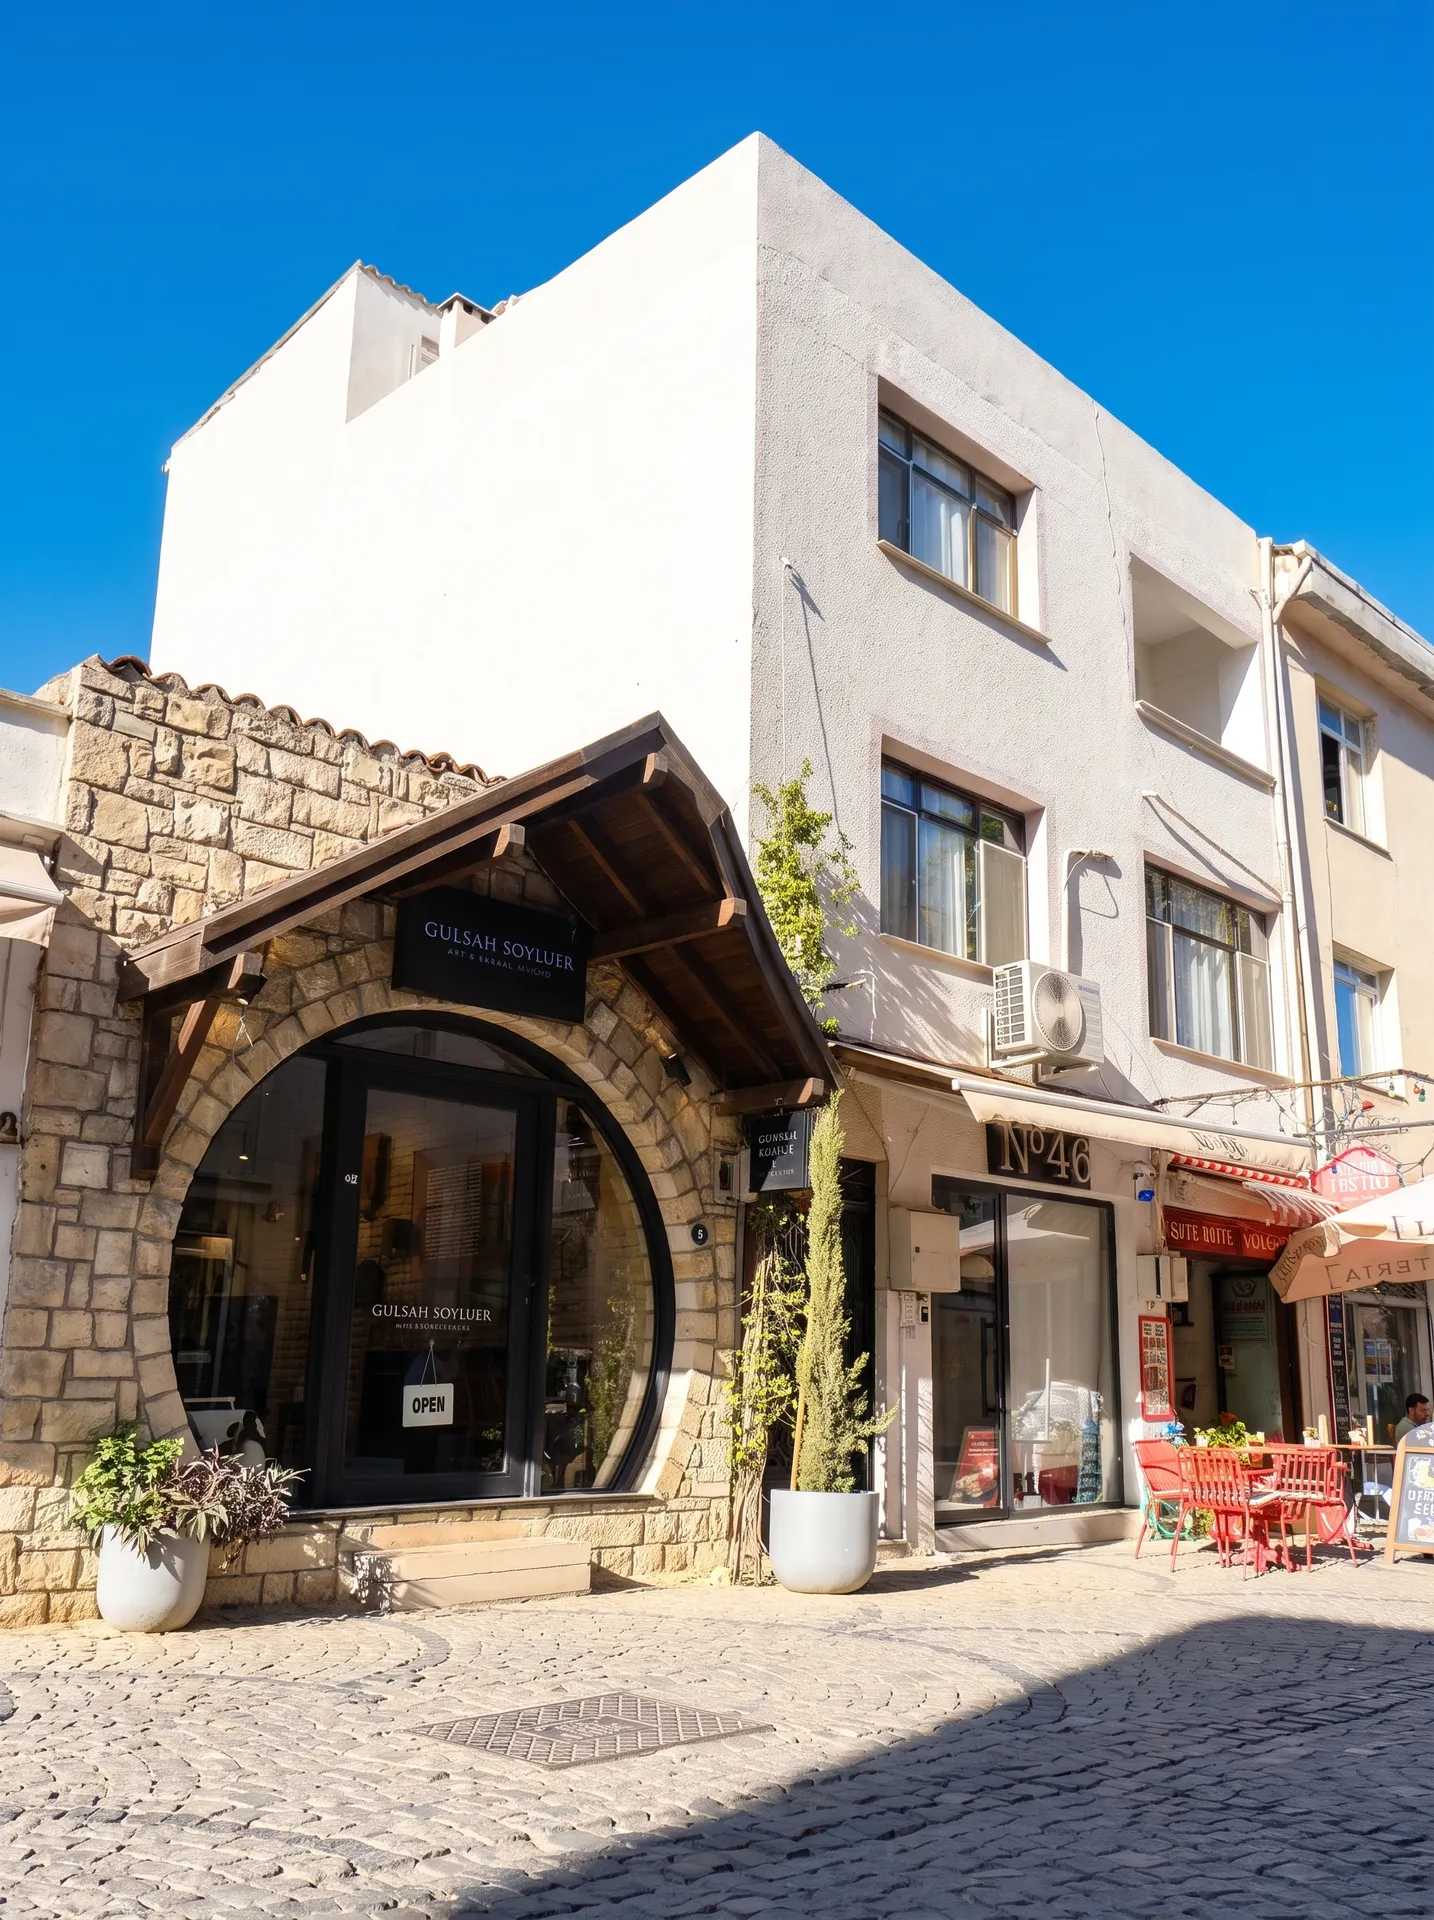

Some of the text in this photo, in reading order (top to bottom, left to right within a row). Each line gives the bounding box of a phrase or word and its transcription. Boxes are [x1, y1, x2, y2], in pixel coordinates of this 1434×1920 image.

[424, 921, 575, 972] GULSAH SOYLUER
[371, 1303, 492, 1322] GULSAH SOYLUER
[412, 1396, 446, 1414] OPEN
